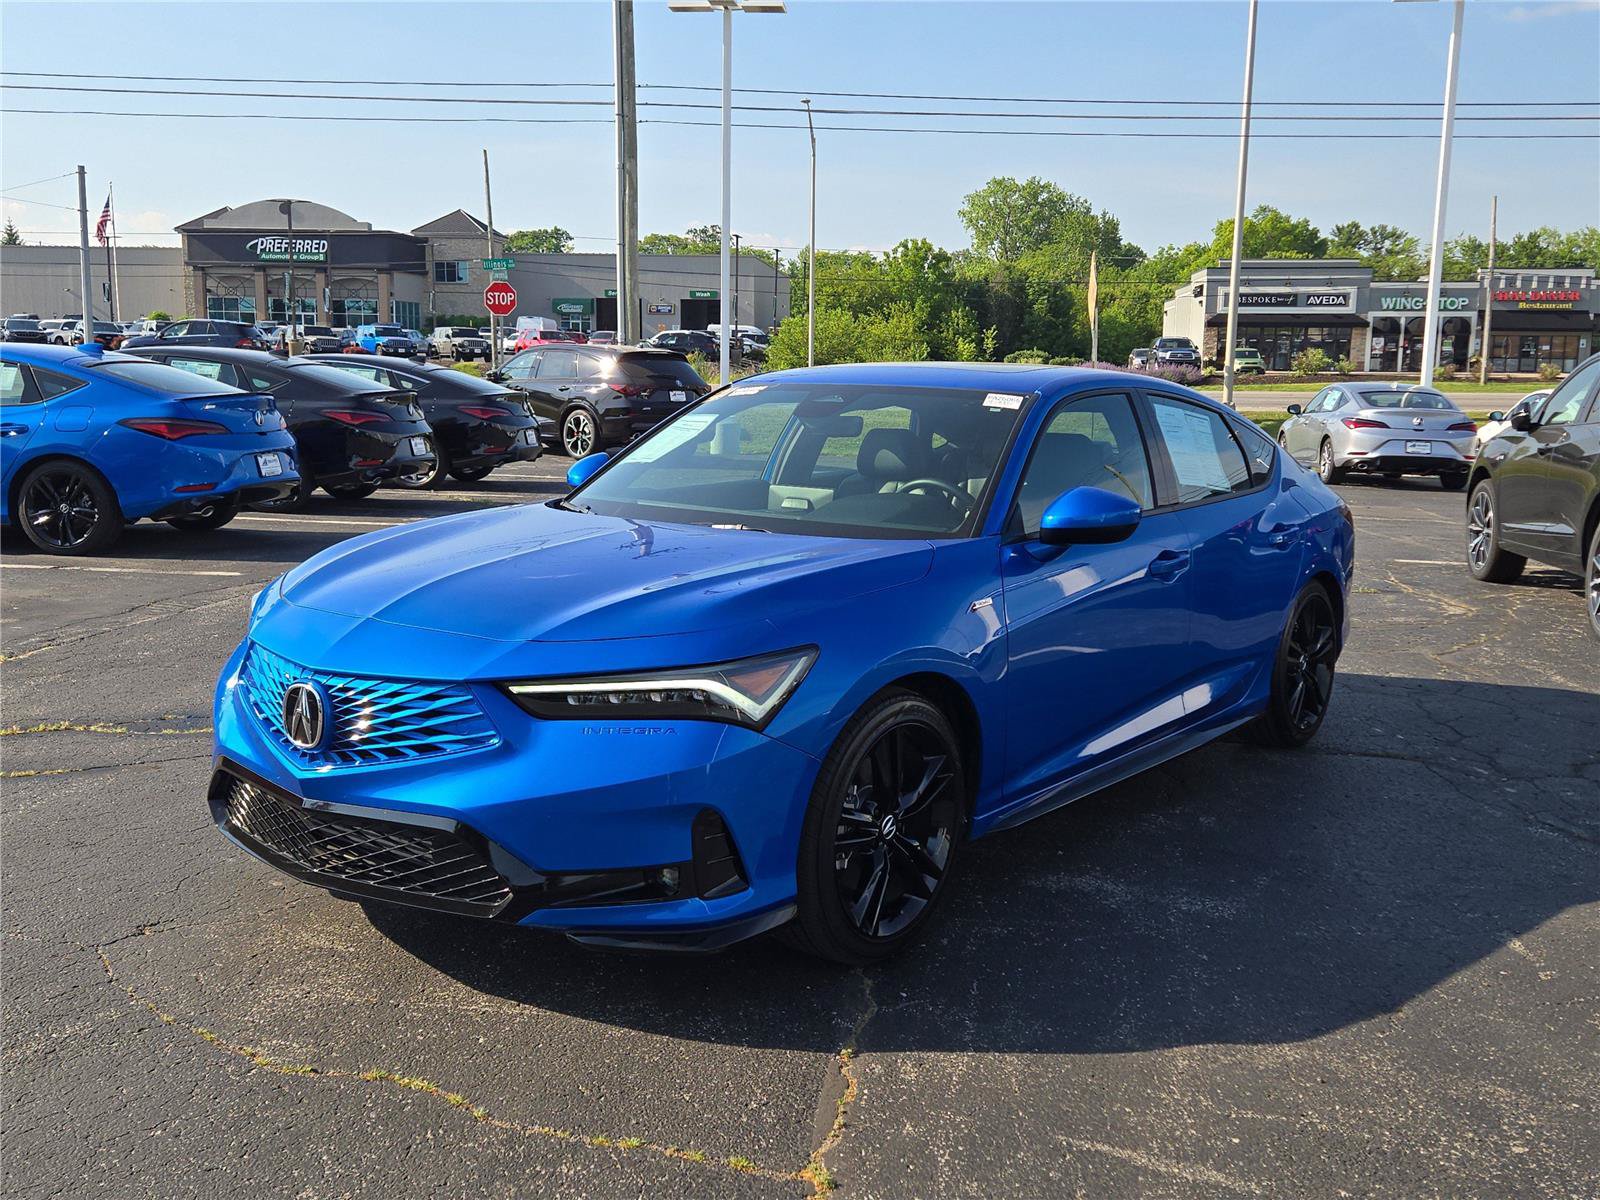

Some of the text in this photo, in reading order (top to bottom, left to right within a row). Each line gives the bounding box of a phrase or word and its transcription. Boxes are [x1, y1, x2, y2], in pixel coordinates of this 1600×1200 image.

[257, 238, 328, 254] PREFERRED
[487, 292, 515, 306] STOP
[1307, 296, 1346, 305] AVEDA
[582, 727, 679, 736] INTEGRA
